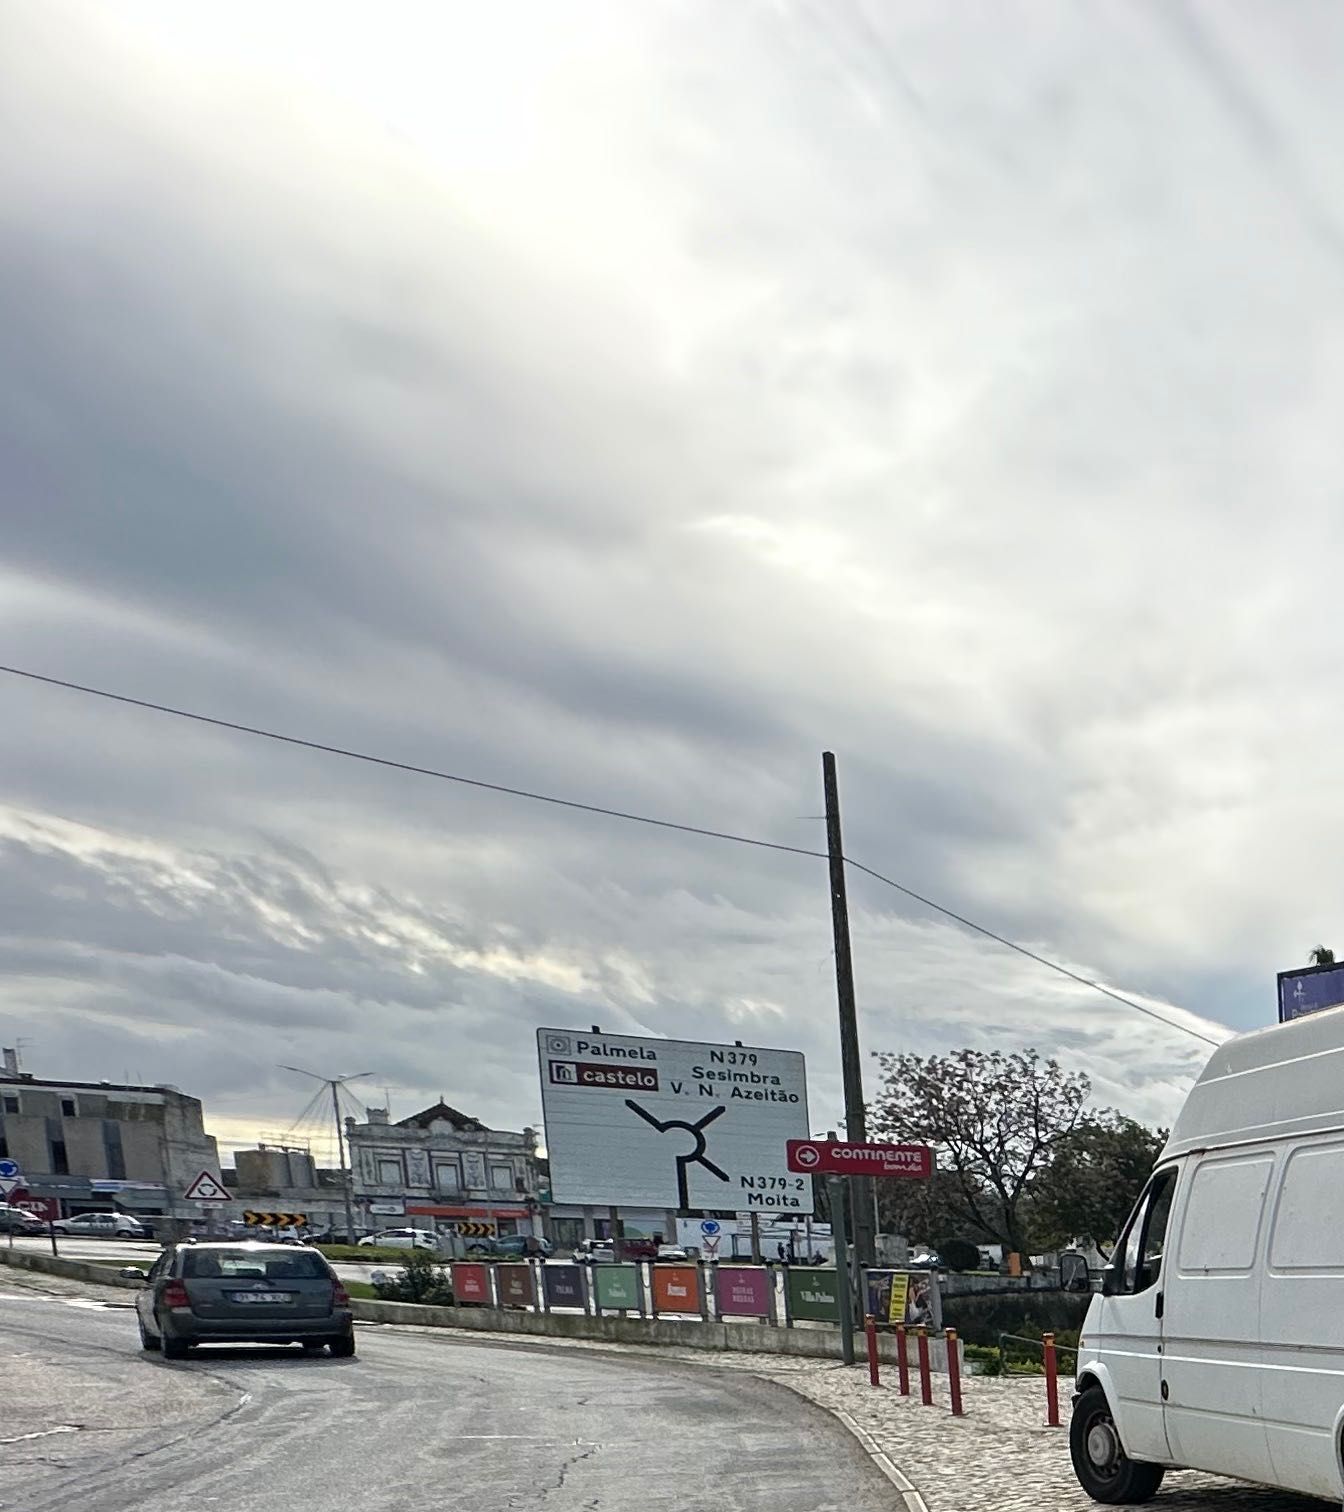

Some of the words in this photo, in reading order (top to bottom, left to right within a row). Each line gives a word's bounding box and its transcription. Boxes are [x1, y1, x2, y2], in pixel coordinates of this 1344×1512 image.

[576, 1041, 657, 1061] Palmela
[583, 1067, 656, 1088] castelo
[692, 1066, 781, 1085] Sesimbra
[731, 1087, 800, 1104] Azeitão
[831, 1147, 922, 1162] CONTINENTE
[741, 1176, 805, 1191] N379-2
[747, 1193, 801, 1208] Moita
